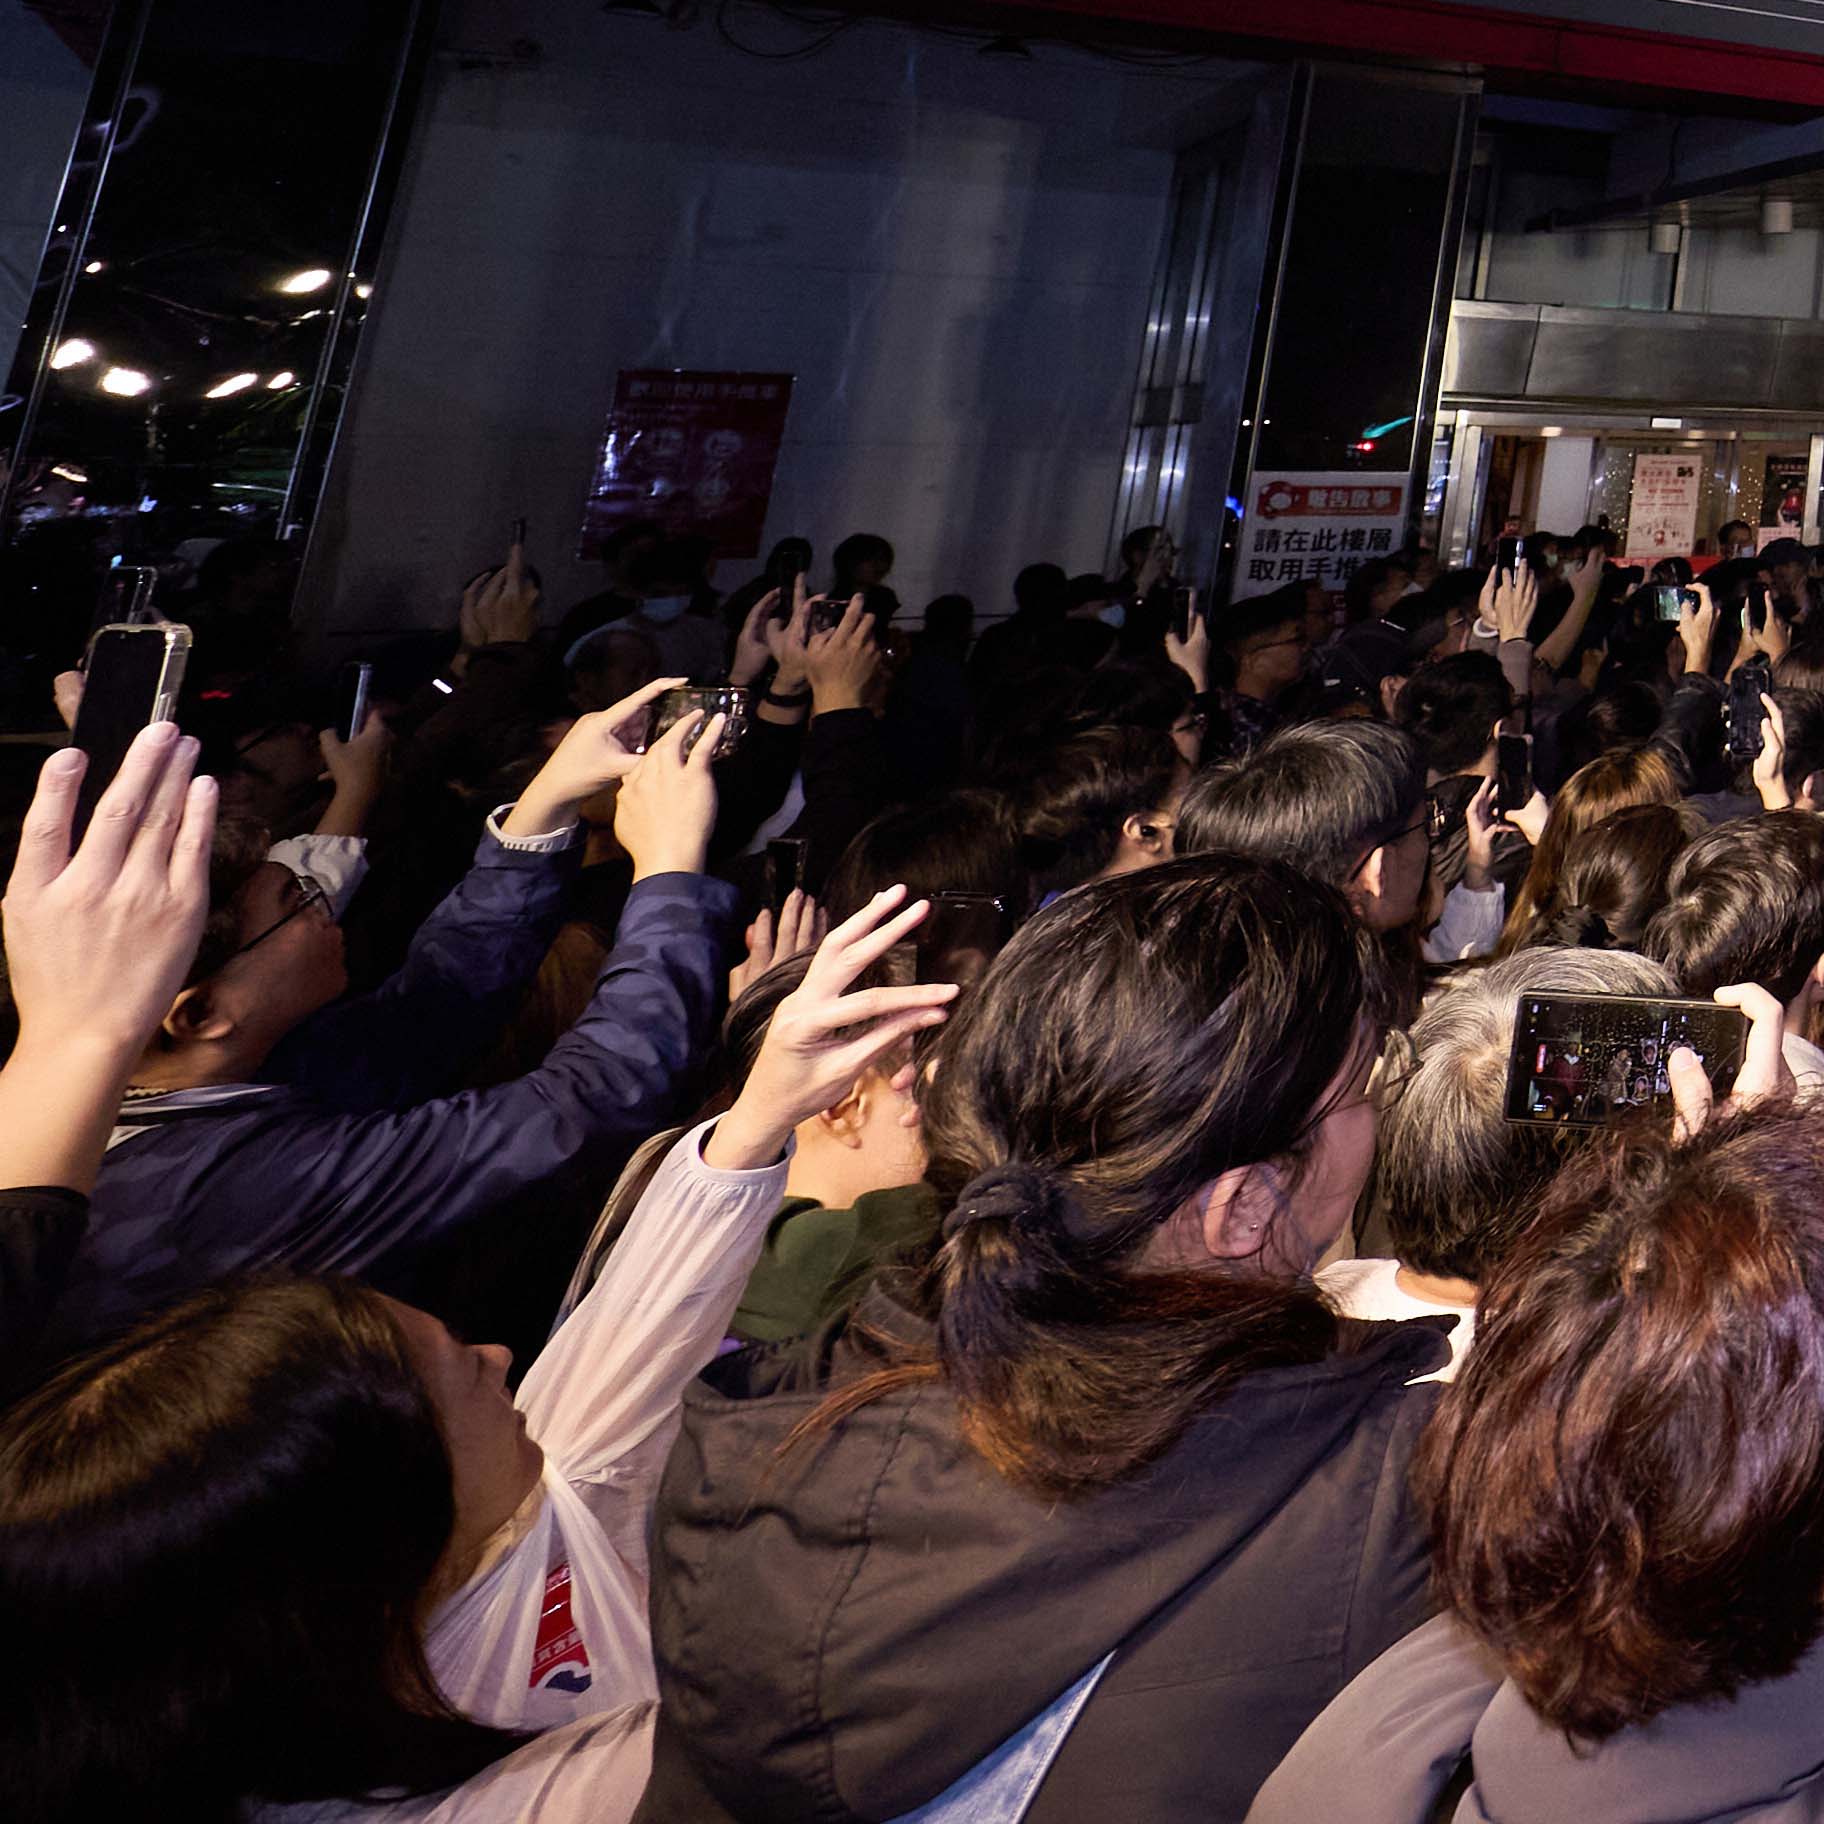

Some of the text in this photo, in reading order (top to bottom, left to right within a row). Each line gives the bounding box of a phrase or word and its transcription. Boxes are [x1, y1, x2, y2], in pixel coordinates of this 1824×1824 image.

[1253, 527, 1393, 554] 請在此樓層
[1247, 557, 1378, 582] 取用手推
